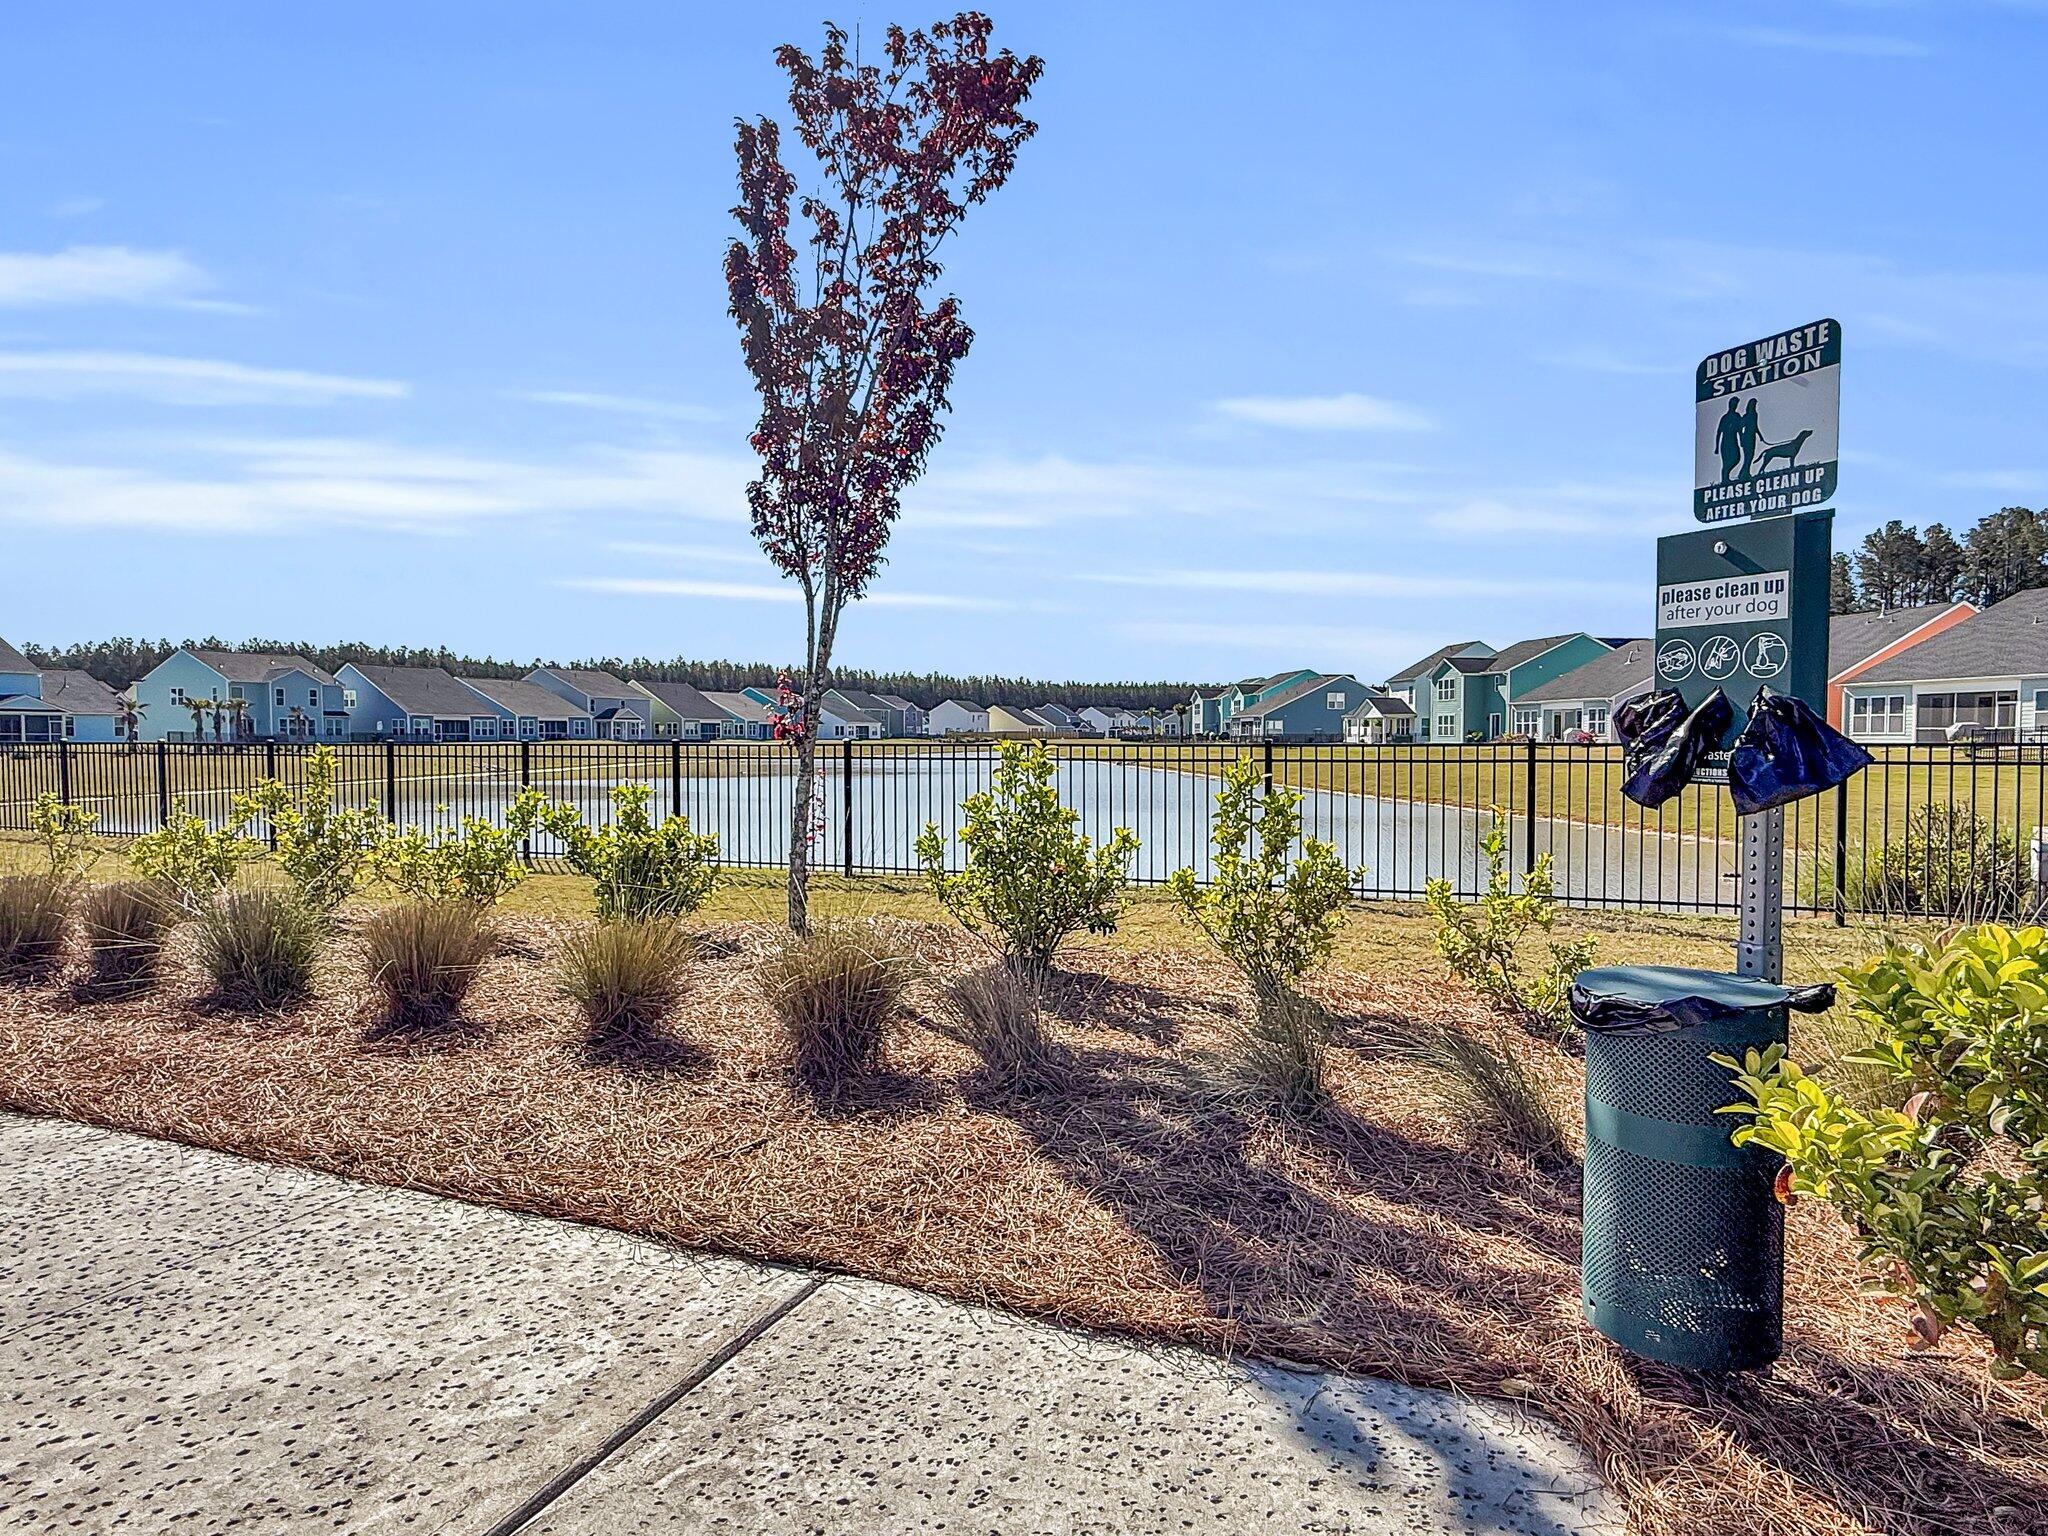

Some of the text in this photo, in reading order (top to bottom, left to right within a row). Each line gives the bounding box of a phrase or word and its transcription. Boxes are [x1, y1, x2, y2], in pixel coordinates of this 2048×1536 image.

[1706, 322, 1829, 378] DOG WASTE
[1713, 350, 1821, 396] STATION
[1703, 467, 1825, 503] PLEASE CLEAN UP
[1706, 487, 1822, 521] AFTER YOUR DOG
[1662, 578, 1785, 606] please clean up
[1666, 598, 1779, 621] after your dog
[1704, 750, 1730, 760] aste
